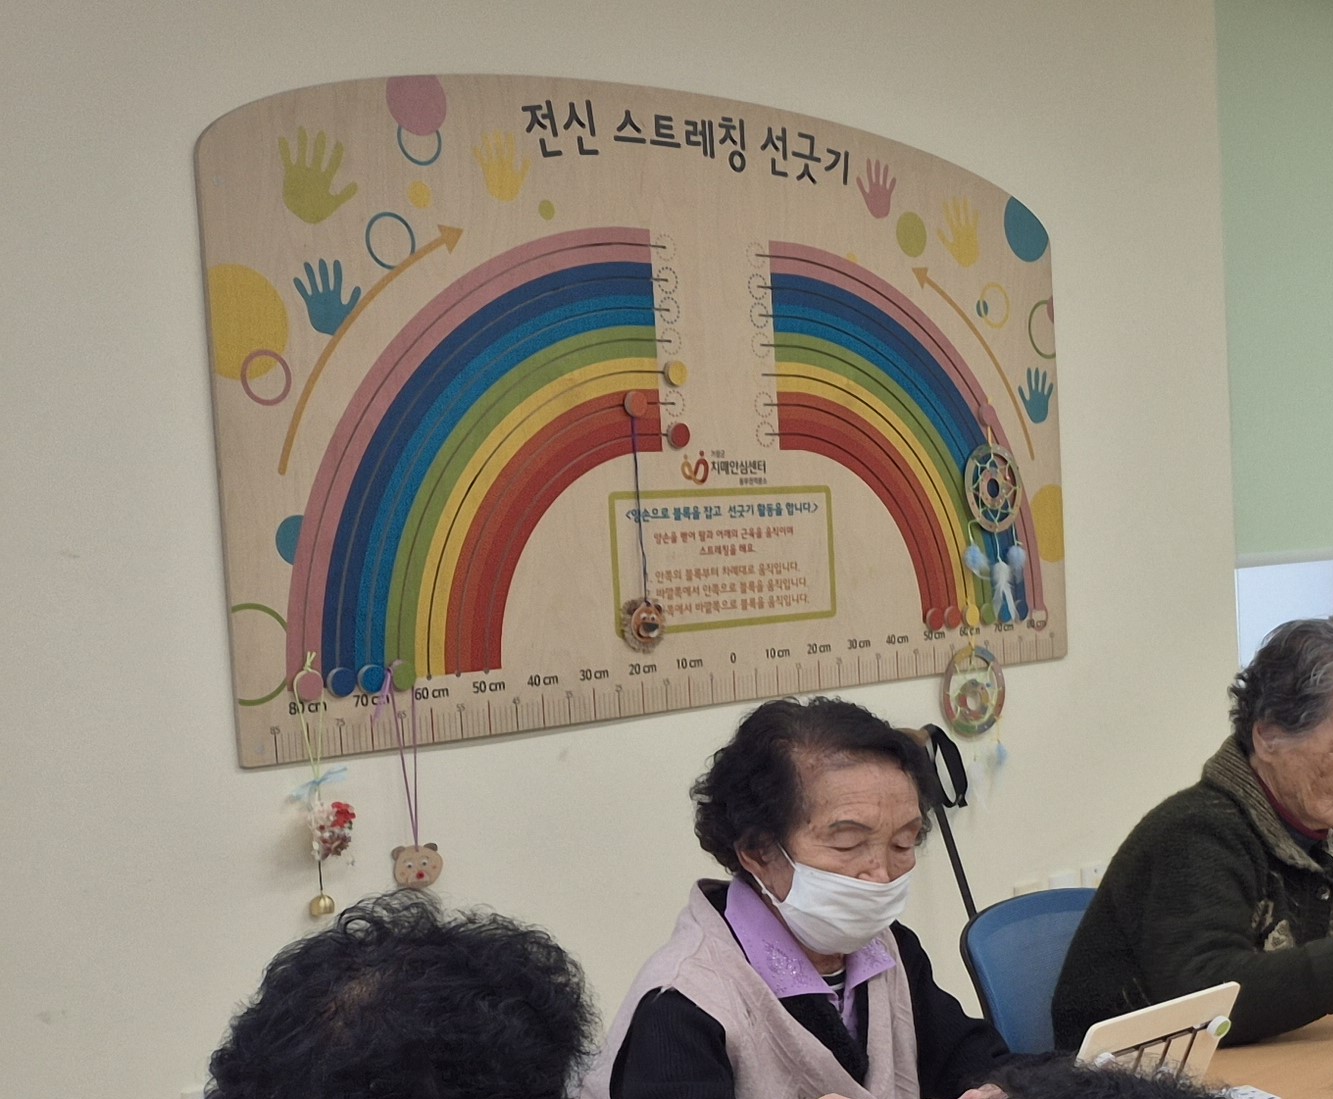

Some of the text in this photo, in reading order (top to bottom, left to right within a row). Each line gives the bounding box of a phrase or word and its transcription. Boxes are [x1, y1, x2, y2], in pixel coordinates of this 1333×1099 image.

[522, 99, 849, 185] 전신 스트레칭 선긋기
[711, 460, 766, 475] 치매안심센터
[673, 506, 701, 521] 블록을
[703, 505, 722, 520] 잡고
[727, 504, 754, 519] 선긋기
[757, 503, 782, 517] 활동을
[1003, 622, 1014, 632] cm
[886, 633, 909, 645] 40 cm
[923, 630, 945, 641] 50 cm
[807, 643, 831, 655] 20 cm
[847, 638, 871, 650] 30 cm
[730, 652, 737, 664] 0
[765, 648, 790, 659] 10 cm
[628, 663, 657, 676] 20 cm
[676, 657, 703, 670] 10 cm
[527, 674, 559, 687] 40 cm
[579, 668, 609, 681] 30 cm
[414, 687, 449, 700] 60 cm
[472, 681, 505, 694] 50 cm
[353, 694, 368, 707] 70
[288, 701, 304, 715] 80
